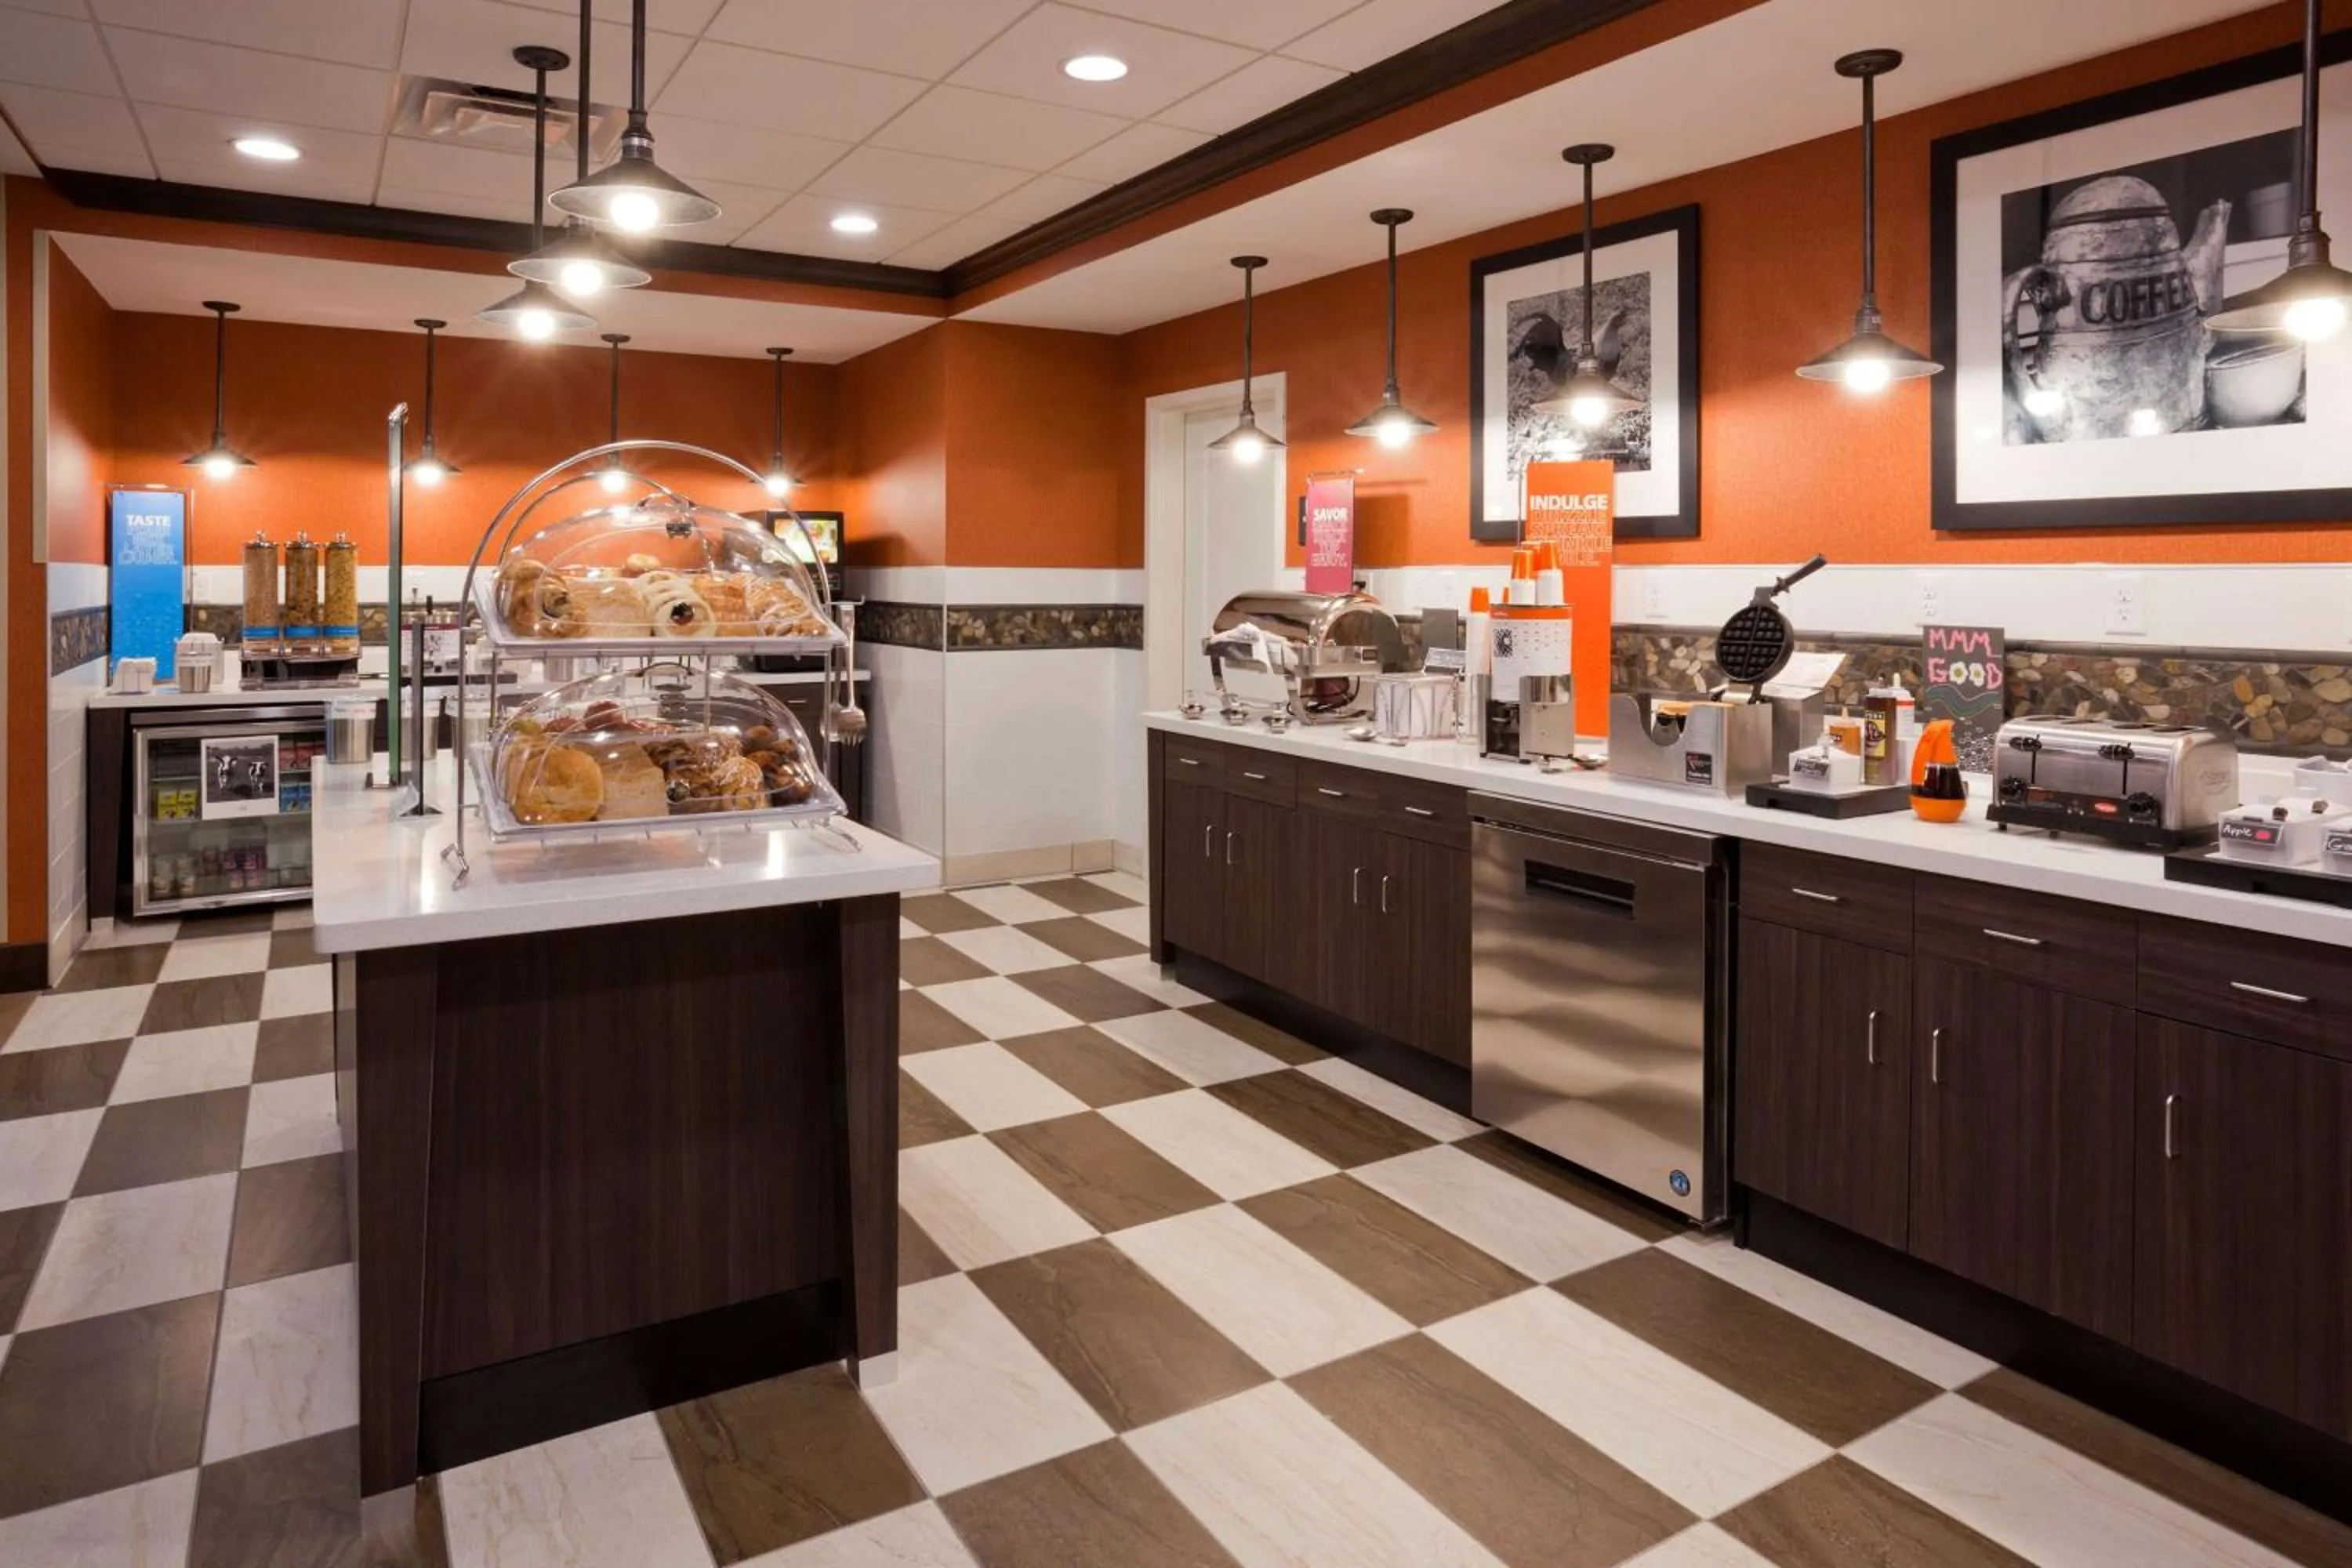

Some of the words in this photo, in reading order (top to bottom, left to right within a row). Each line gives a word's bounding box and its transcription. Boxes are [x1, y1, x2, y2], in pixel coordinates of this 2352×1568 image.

[1530, 494, 1608, 510] INDULGE
[125, 514, 172, 525] TASTE
[1313, 507, 1348, 521] SAVOR
[1929, 657, 2002, 690] GOOD
[2223, 824, 2252, 837] Apple
